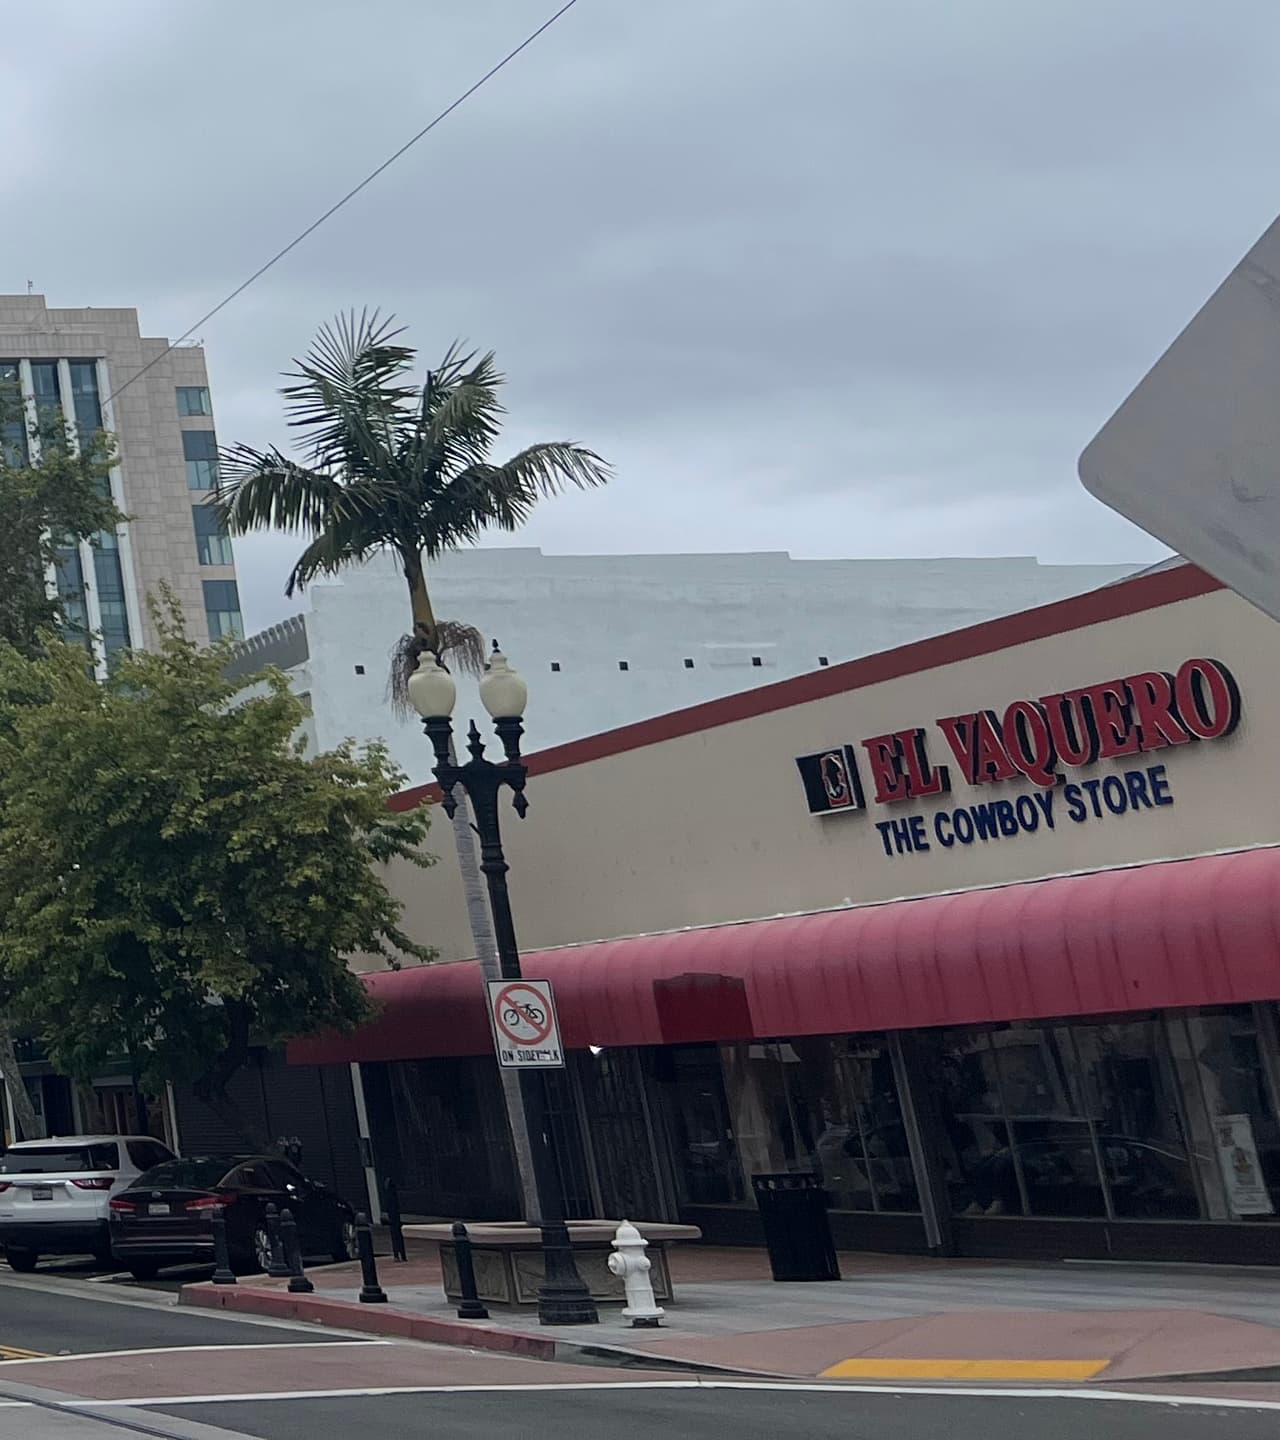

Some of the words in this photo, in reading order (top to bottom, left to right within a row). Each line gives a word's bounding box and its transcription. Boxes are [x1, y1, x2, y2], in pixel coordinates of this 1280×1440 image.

[861, 727, 948, 804] EL
[936, 657, 1240, 788] VAQUERO
[874, 815, 930, 857] THE
[934, 790, 1056, 848] COWBOY
[1063, 765, 1174, 824] STORE
[501, 1049, 514, 1062] ON
